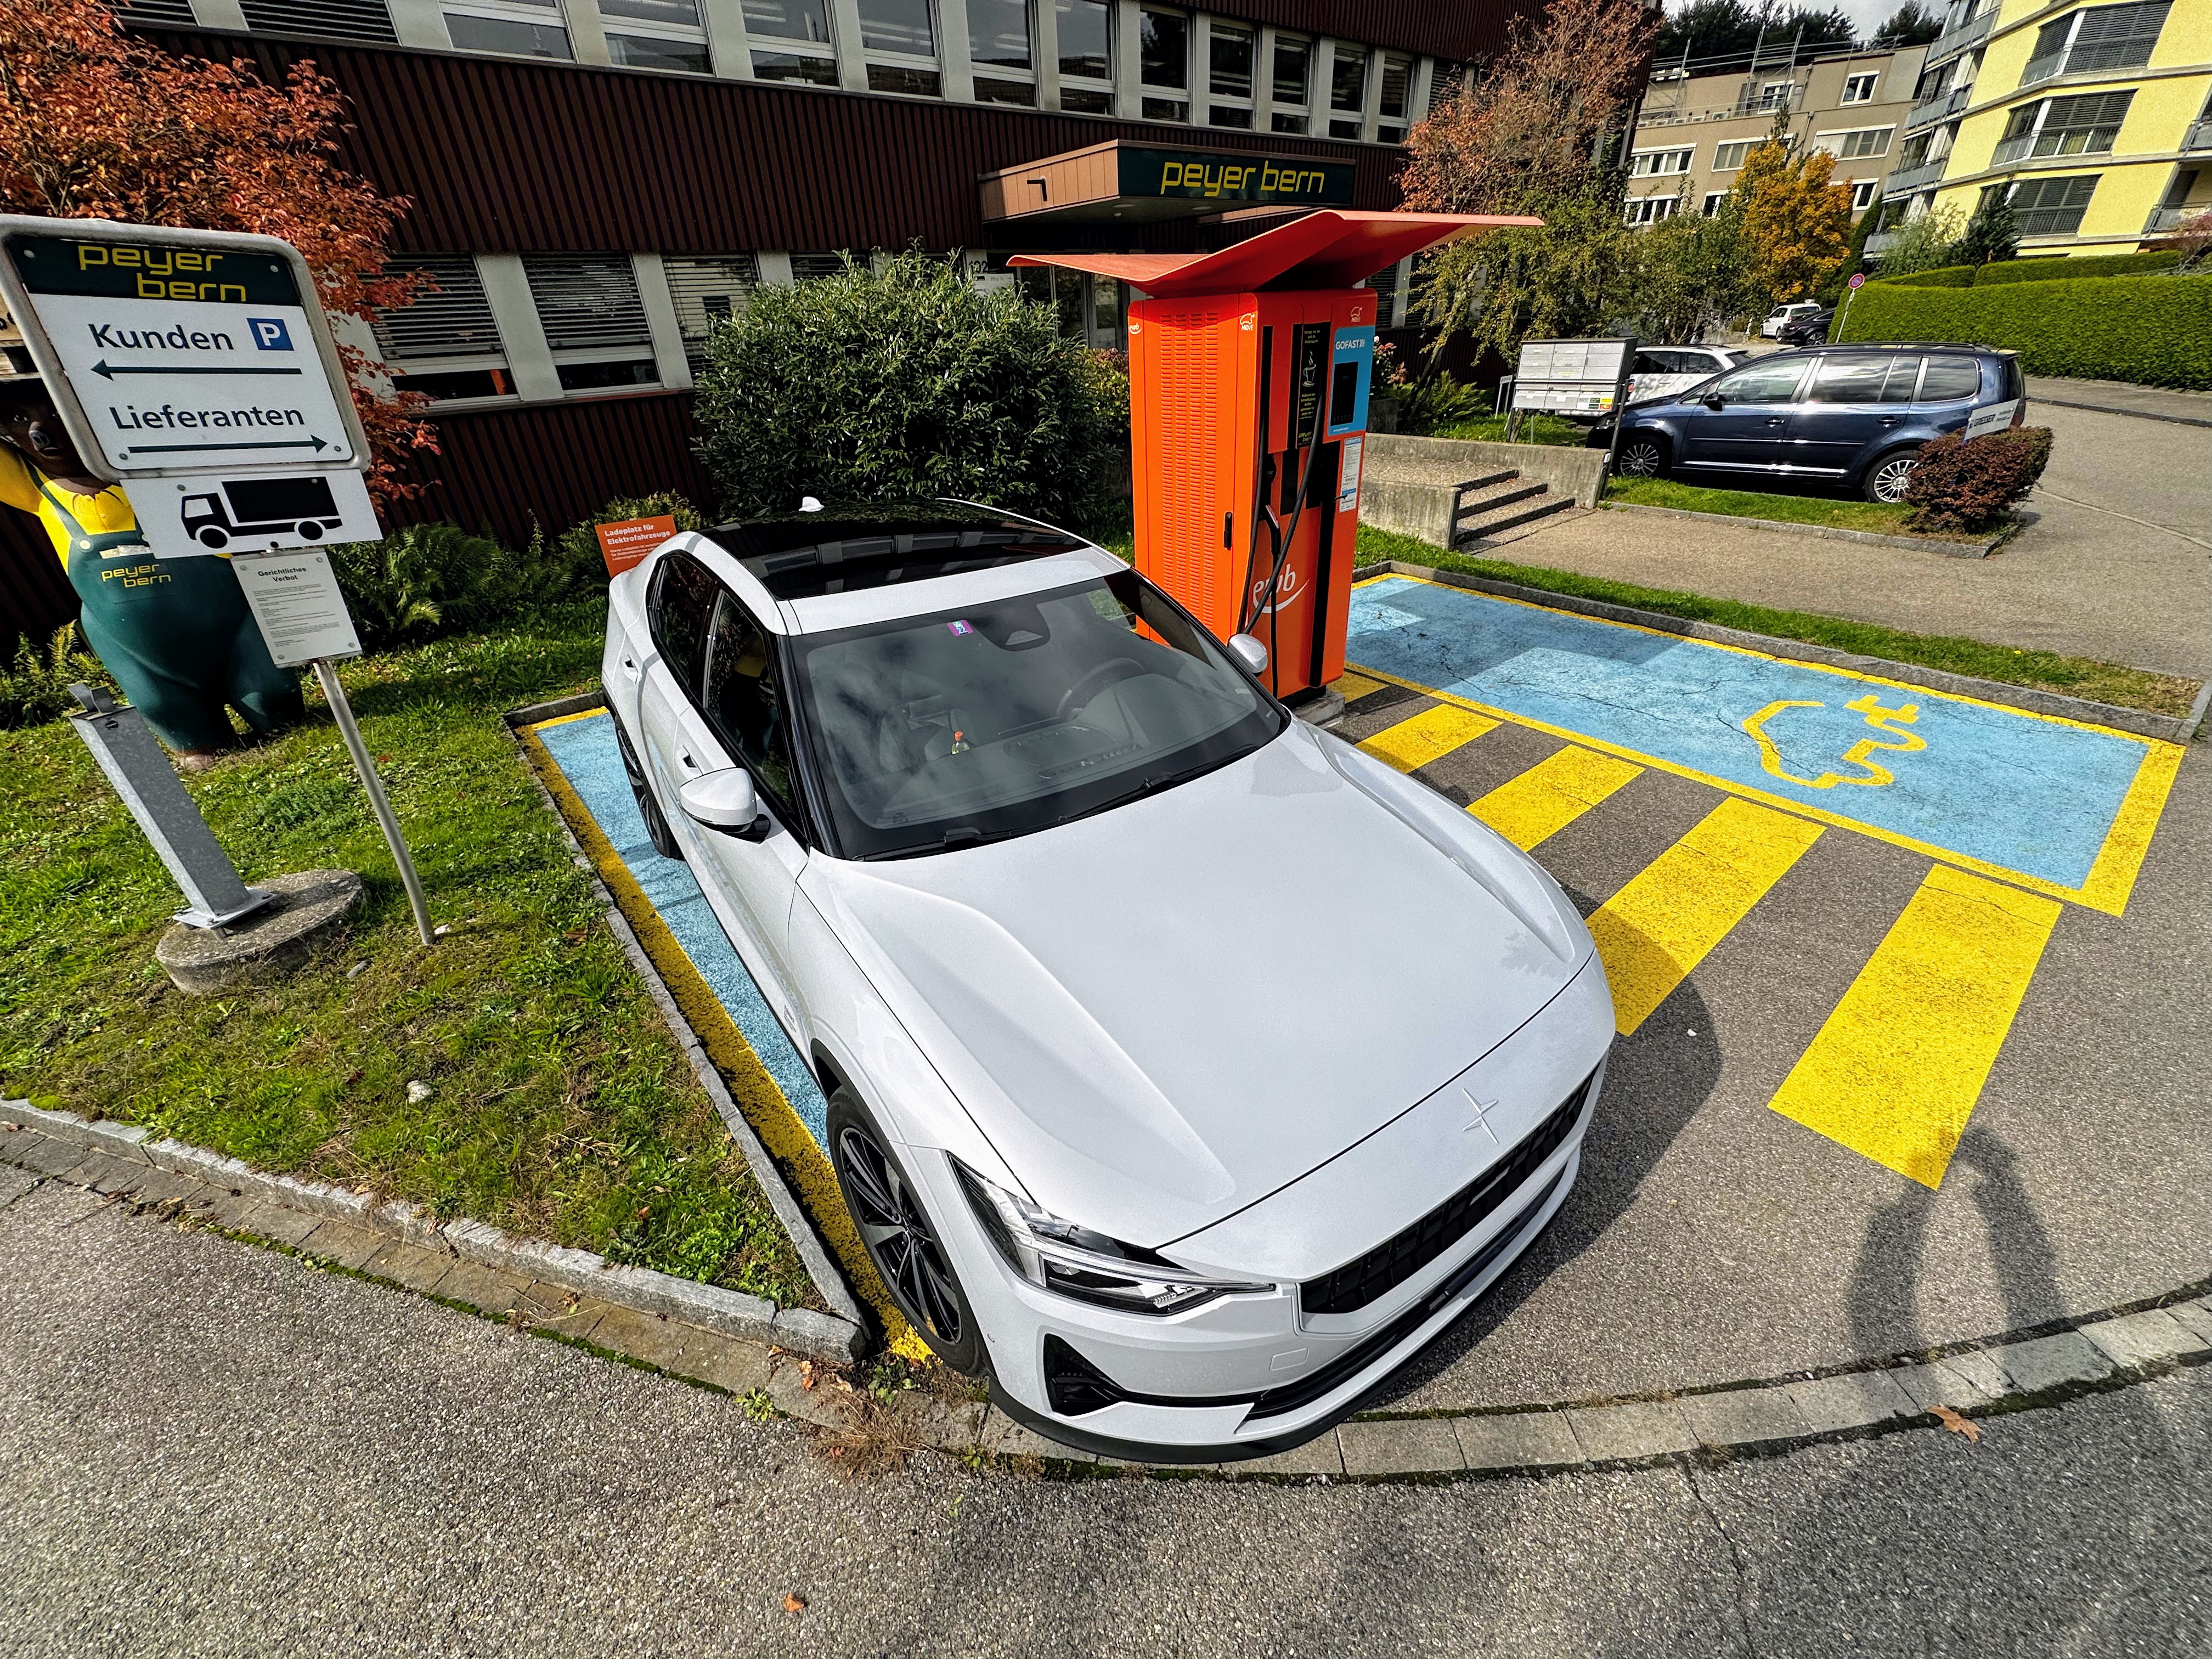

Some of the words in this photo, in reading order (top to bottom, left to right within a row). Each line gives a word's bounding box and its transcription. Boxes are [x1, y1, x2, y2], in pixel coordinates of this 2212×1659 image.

[1160, 162, 1256, 196] peyer
[1260, 160, 1325, 193] bern
[78, 245, 223, 275] peyer
[137, 273, 246, 302] bern
[87, 324, 234, 350] Kunden
[258, 323, 281, 347] P
[1335, 339, 1360, 350] GOFAST
[109, 404, 305, 430] Lieferanten
[604, 526, 642, 537] Ladeplatz
[607, 531, 670, 545] Elektrofahrzeuge
[101, 563, 160, 582] peyer
[123, 574, 172, 588] bern
[258, 567, 307, 577] Gerichtliches
